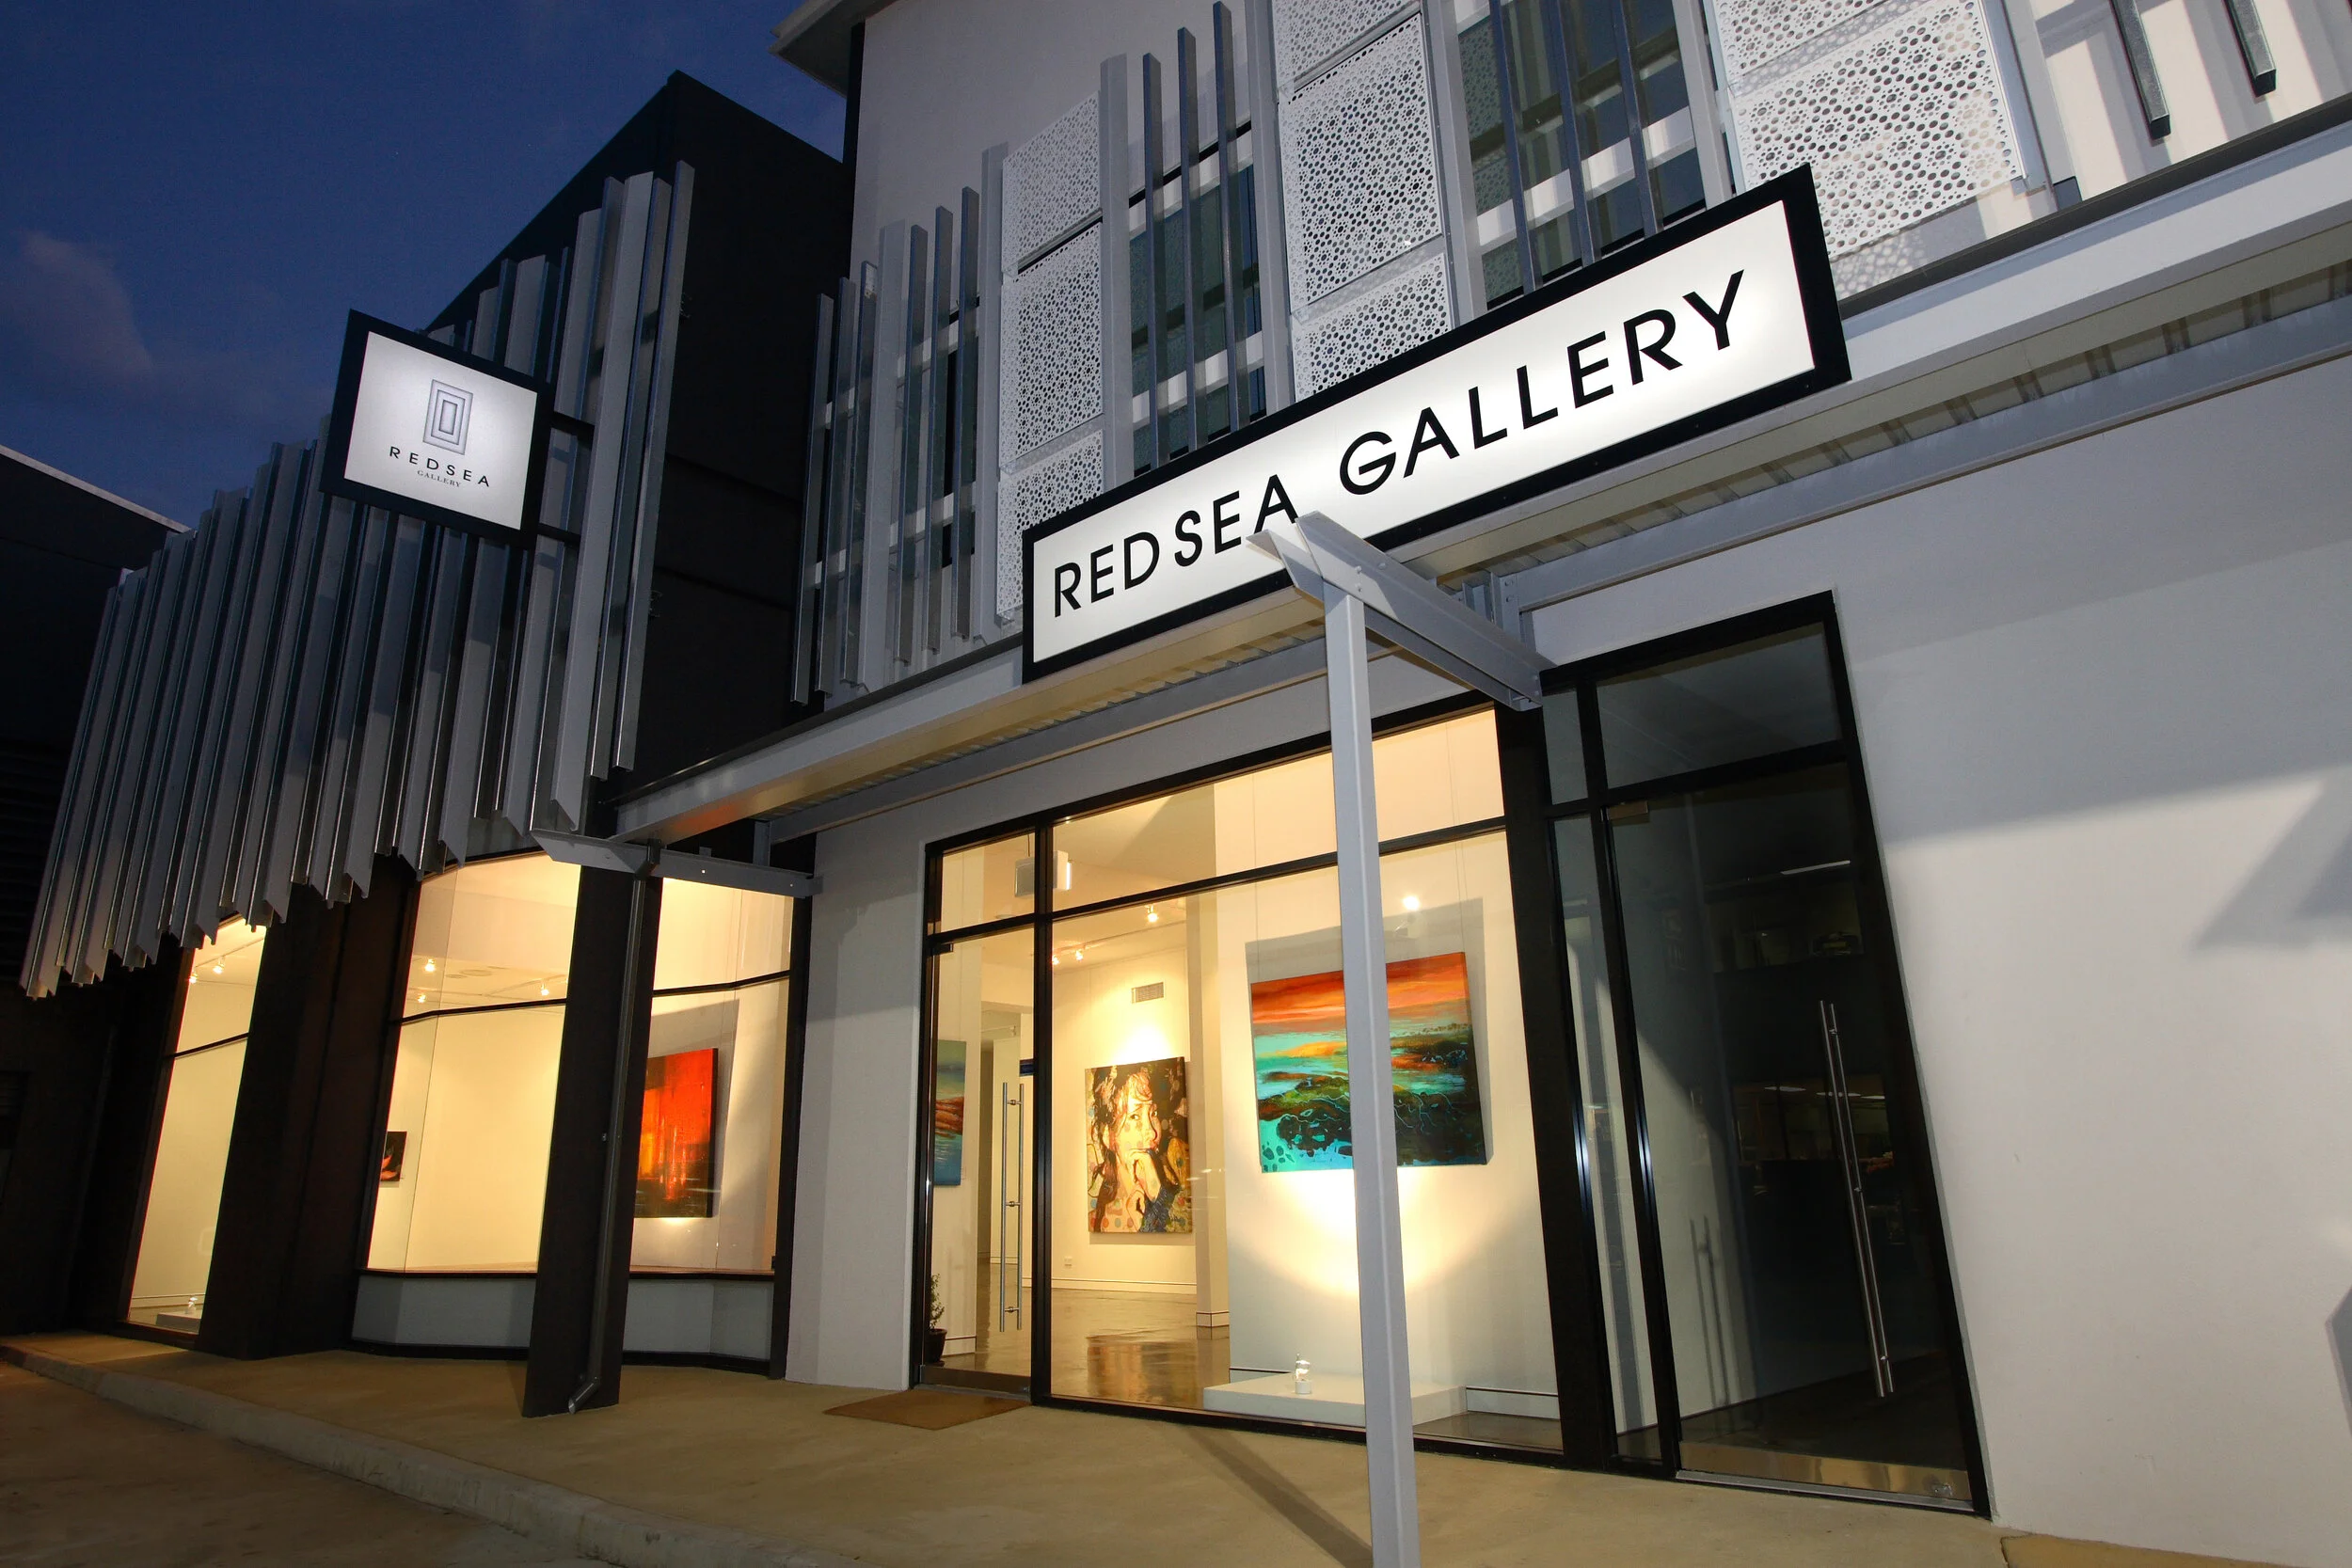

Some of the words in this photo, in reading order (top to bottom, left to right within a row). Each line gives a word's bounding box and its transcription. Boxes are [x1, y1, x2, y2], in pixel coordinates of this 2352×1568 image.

[1054, 474, 1300, 618] REDSEA
[1339, 269, 1744, 496] GALLERY
[389, 446, 490, 487] REDSEA
[417, 469, 461, 488] GALLERY
